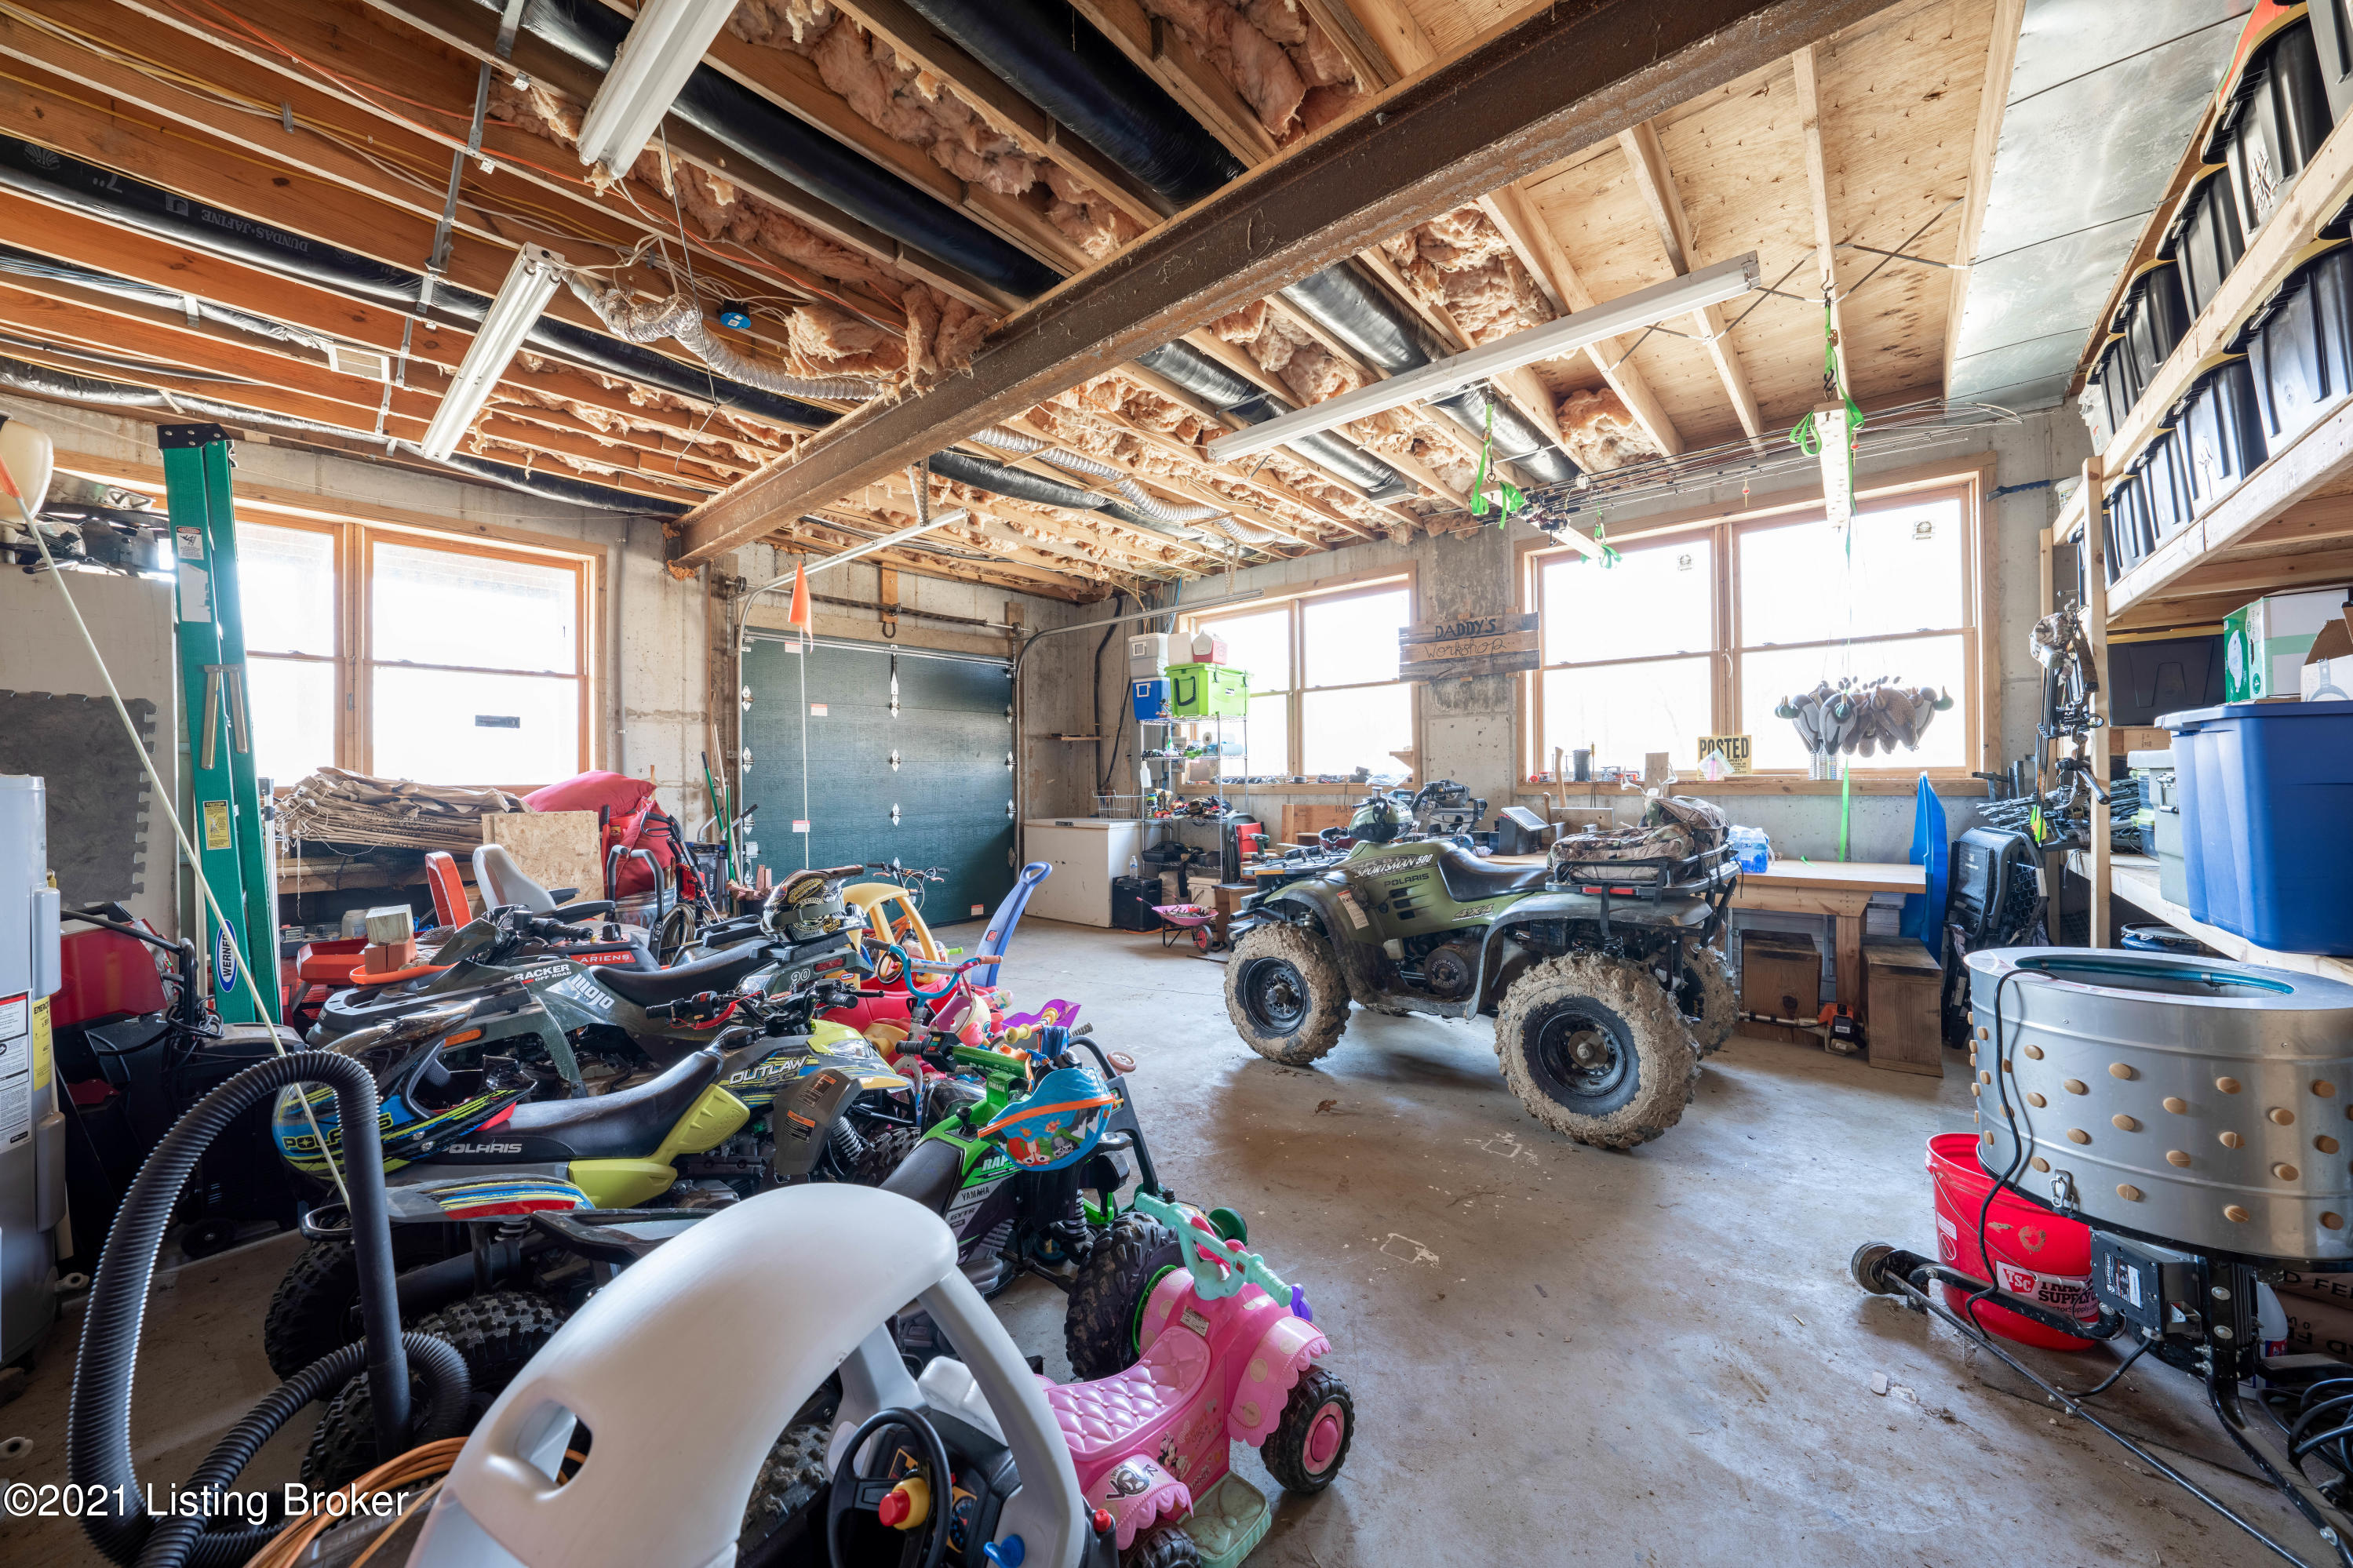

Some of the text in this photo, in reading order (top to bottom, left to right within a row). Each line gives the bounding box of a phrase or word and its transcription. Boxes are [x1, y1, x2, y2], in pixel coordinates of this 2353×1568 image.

[1435, 617, 1497, 638] DADDY'S
[1699, 737, 1749, 759] POSTED
[1354, 853, 1433, 879] SPORTSMAN 500
[1384, 873, 1430, 888] POLARIS
[579, 954, 631, 963] ARIENS
[1431, 959, 1459, 973] AUTOMATIC
[791, 968, 810, 984] 90
[729, 1055, 810, 1086] OUTLAW
[989, 1082, 1005, 1093] YAMAHA
[282, 1112, 394, 1150] POLAS
[961, 1186, 990, 1202] YAMAHA
[2005, 1269, 2031, 1292] TSC
[2038, 1290, 2091, 1304] SUPPLY
